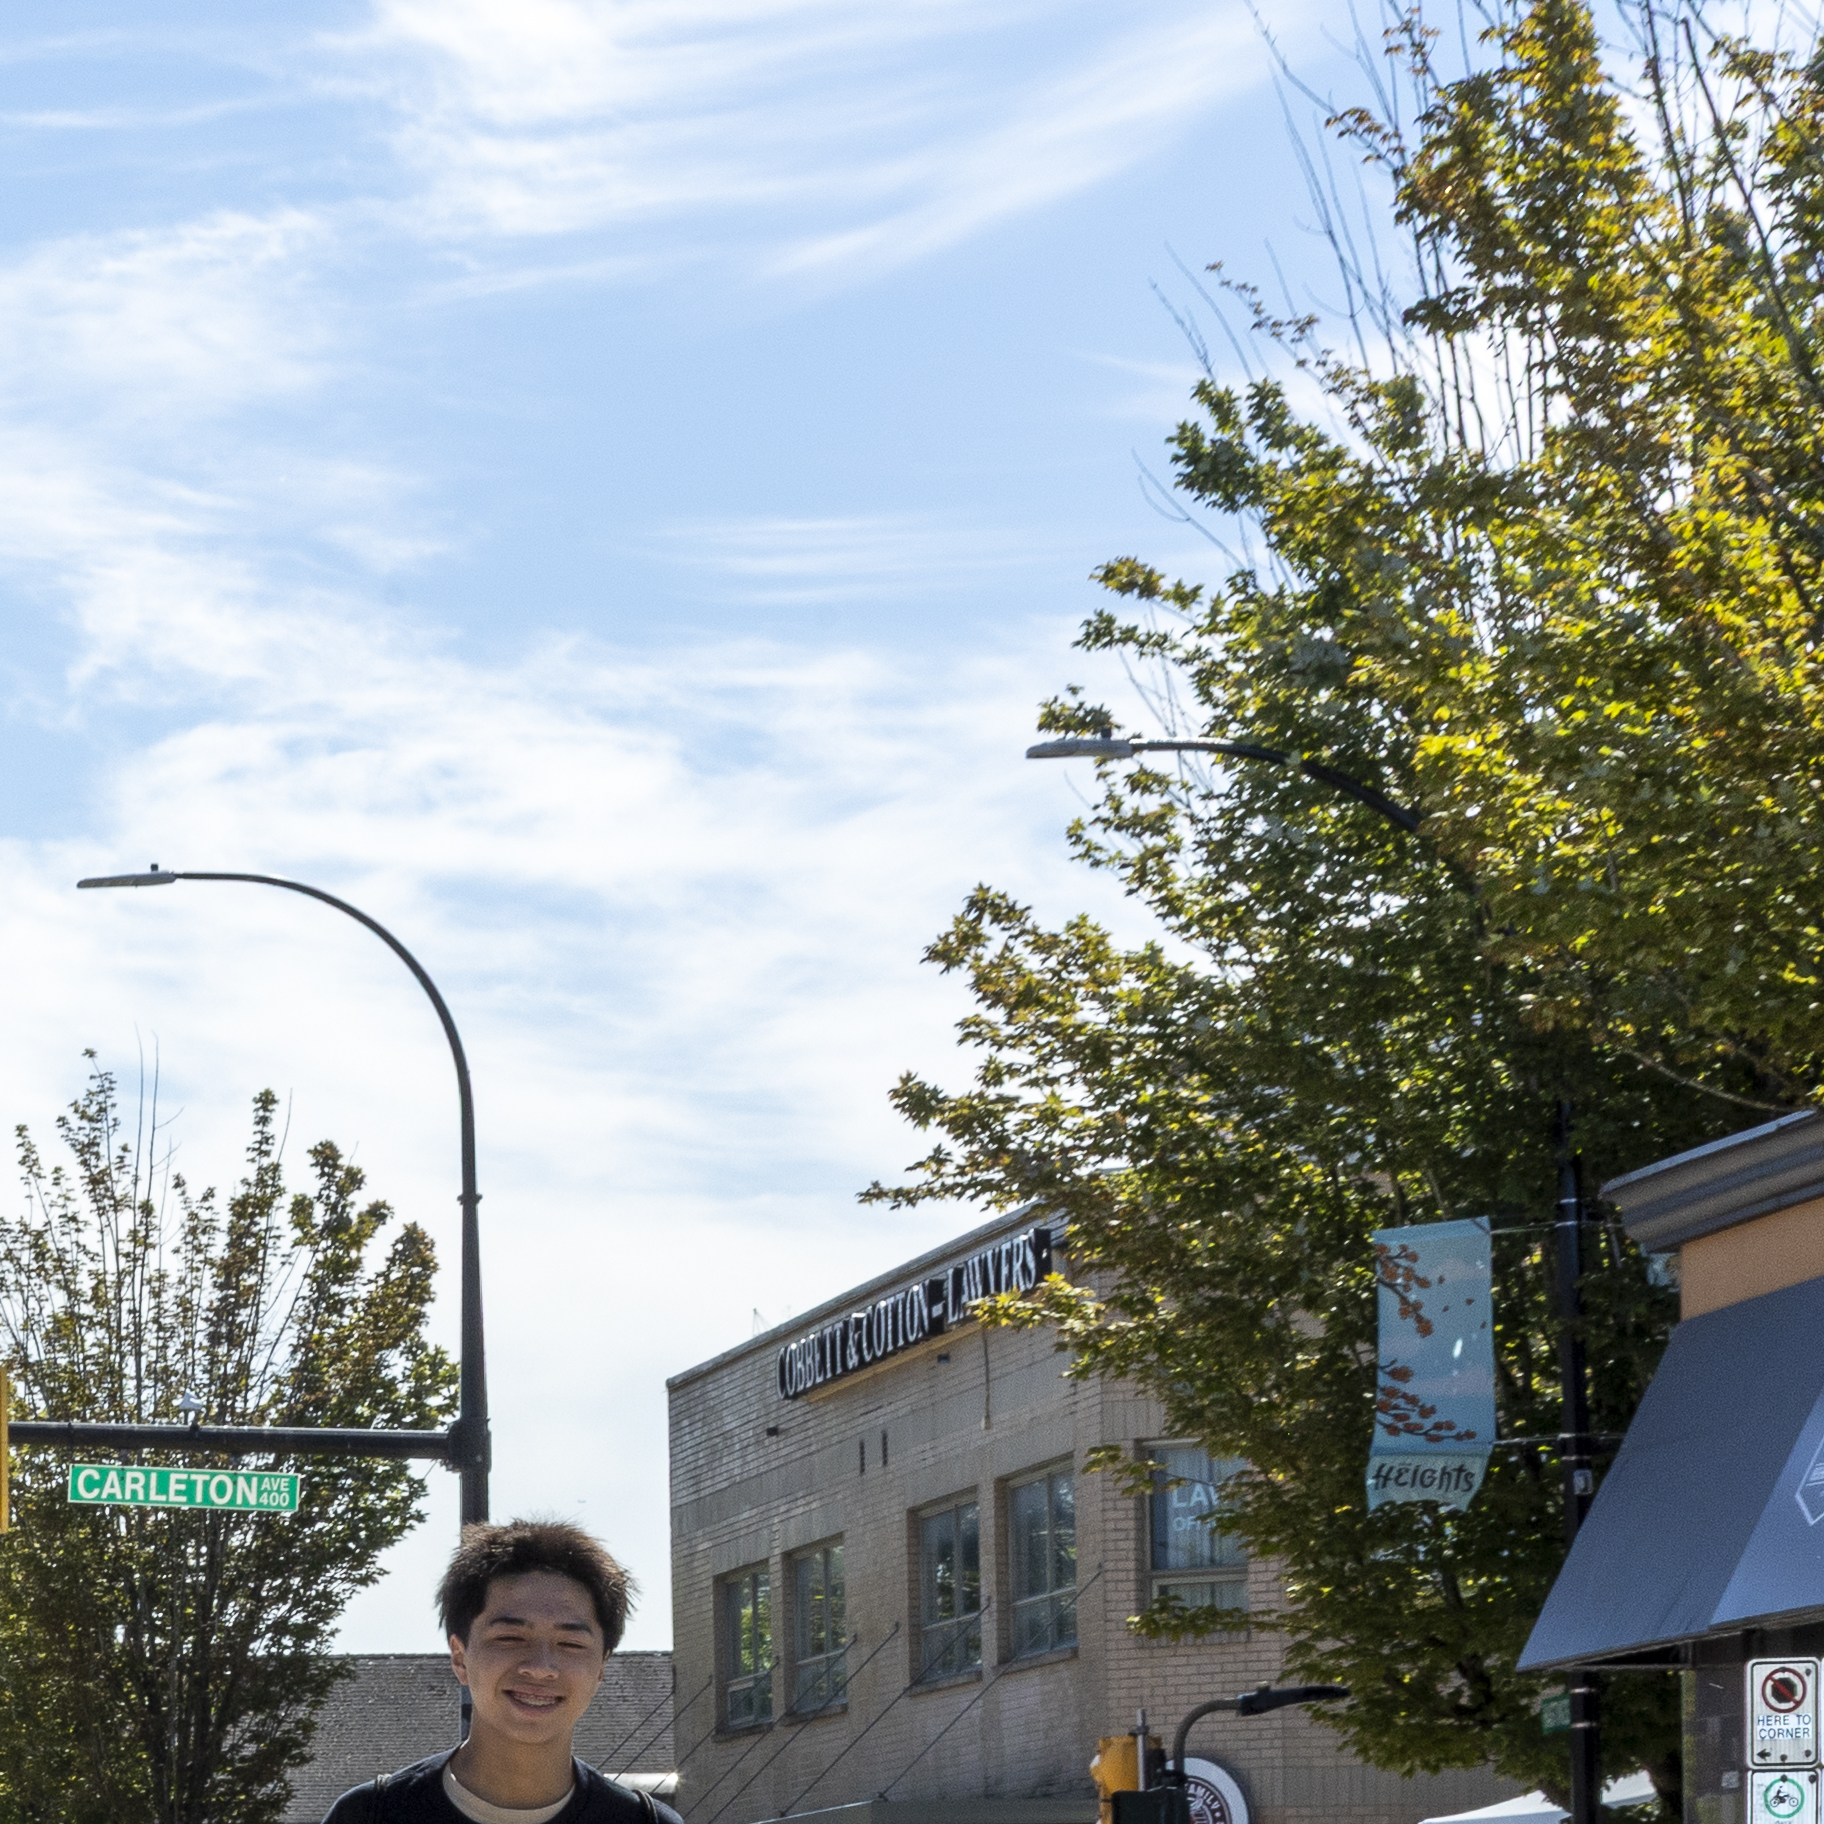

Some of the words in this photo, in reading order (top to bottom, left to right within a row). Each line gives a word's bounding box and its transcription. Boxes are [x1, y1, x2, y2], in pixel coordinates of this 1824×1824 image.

[777, 1322, 843, 1400] COBBETT
[77, 1469, 258, 1506] CARLETON
[260, 1477, 290, 1492] AVE
[259, 1491, 290, 1507] 400
[1757, 1714, 1789, 1726] HERE
[1796, 1713, 1812, 1726] TO
[1758, 1727, 1811, 1740] CORNER
